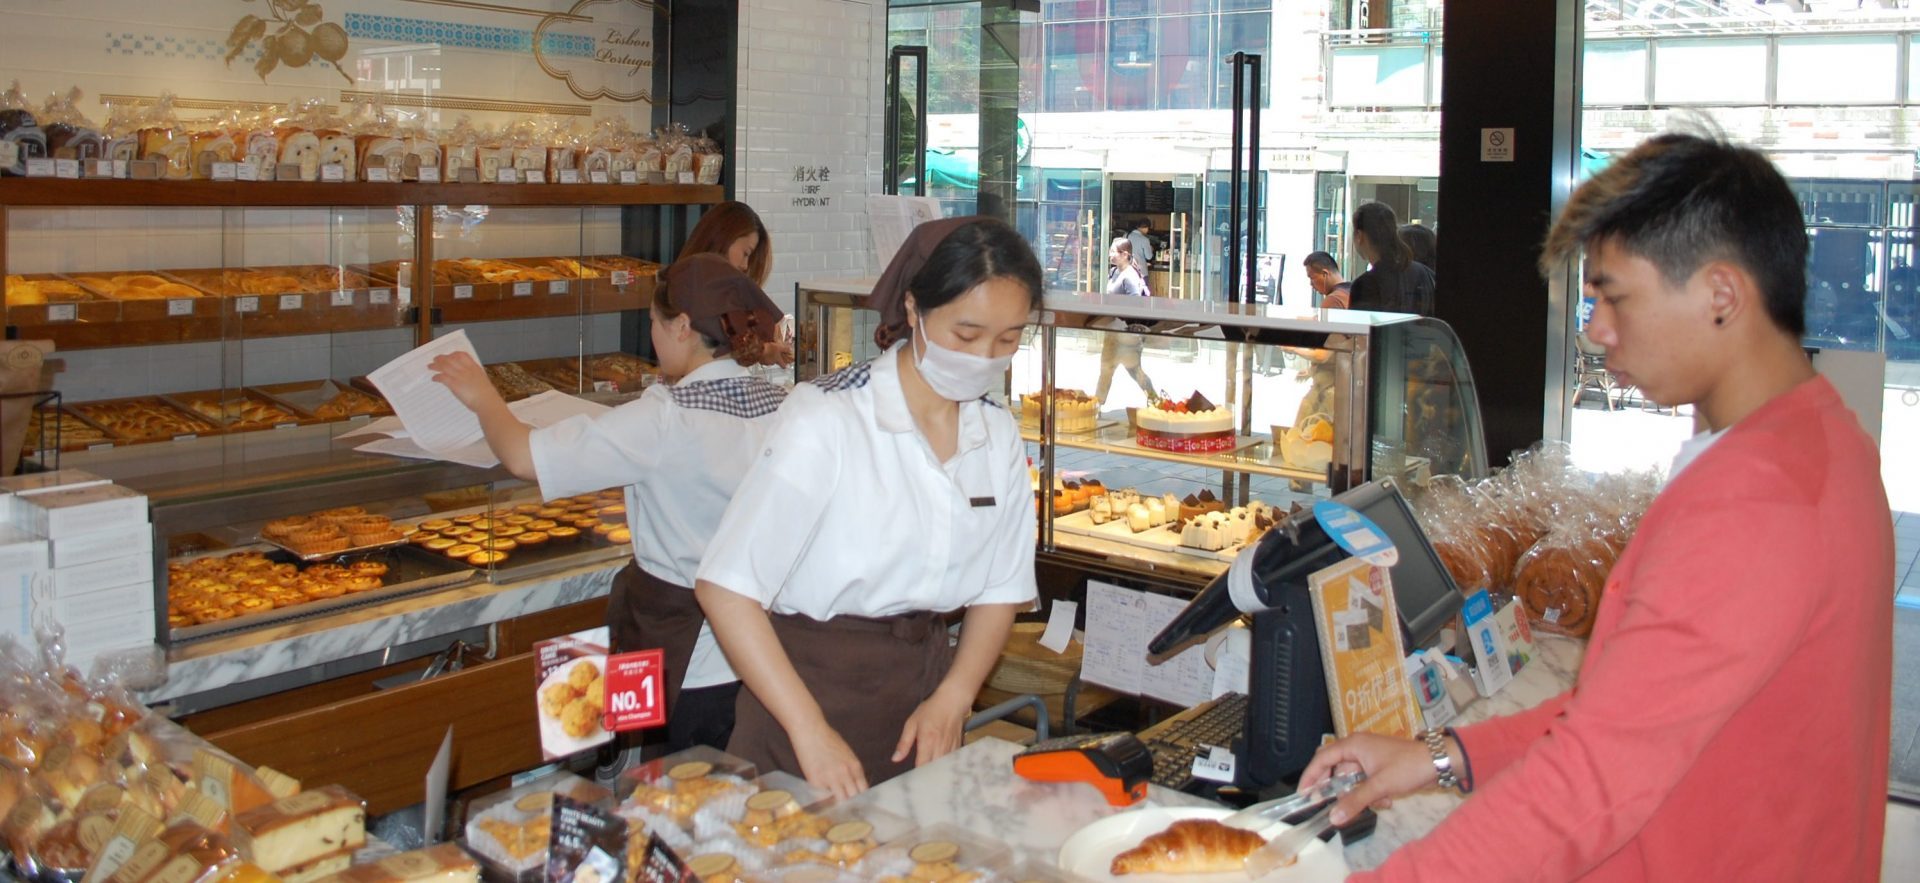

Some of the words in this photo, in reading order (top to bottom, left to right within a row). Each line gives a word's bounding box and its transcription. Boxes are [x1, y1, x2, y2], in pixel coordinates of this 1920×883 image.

[602, 27, 650, 48] Lisbon
[792, 165, 830, 182] 消火栓
